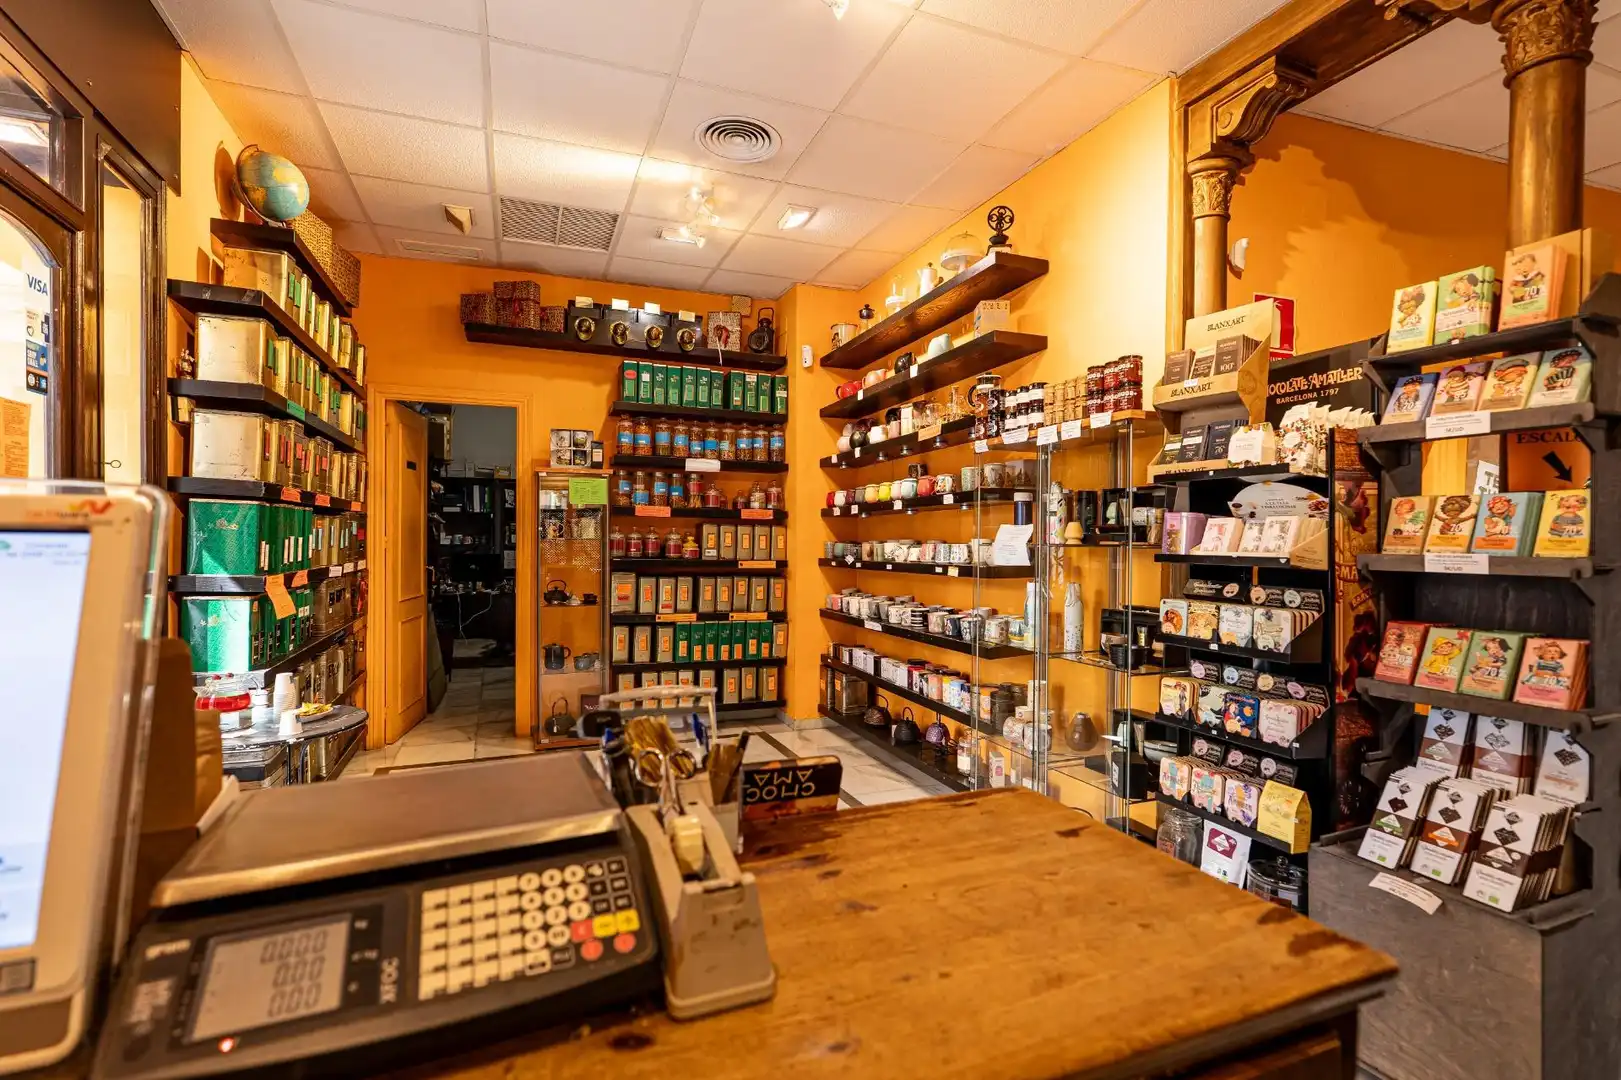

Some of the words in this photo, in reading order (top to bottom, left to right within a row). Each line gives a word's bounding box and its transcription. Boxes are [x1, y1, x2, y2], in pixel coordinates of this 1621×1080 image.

[26, 272, 48, 295] VISA
[1207, 315, 1246, 331] BLANXART
[1170, 382, 1213, 398] BLANXART
[1267, 376, 1308, 398] OCOLATE
[1276, 391, 1318, 404] BARCELONA
[1320, 388, 1340, 397] 1797
[754, 769, 813, 786] AMA
[746, 782, 815, 802] CHOC
